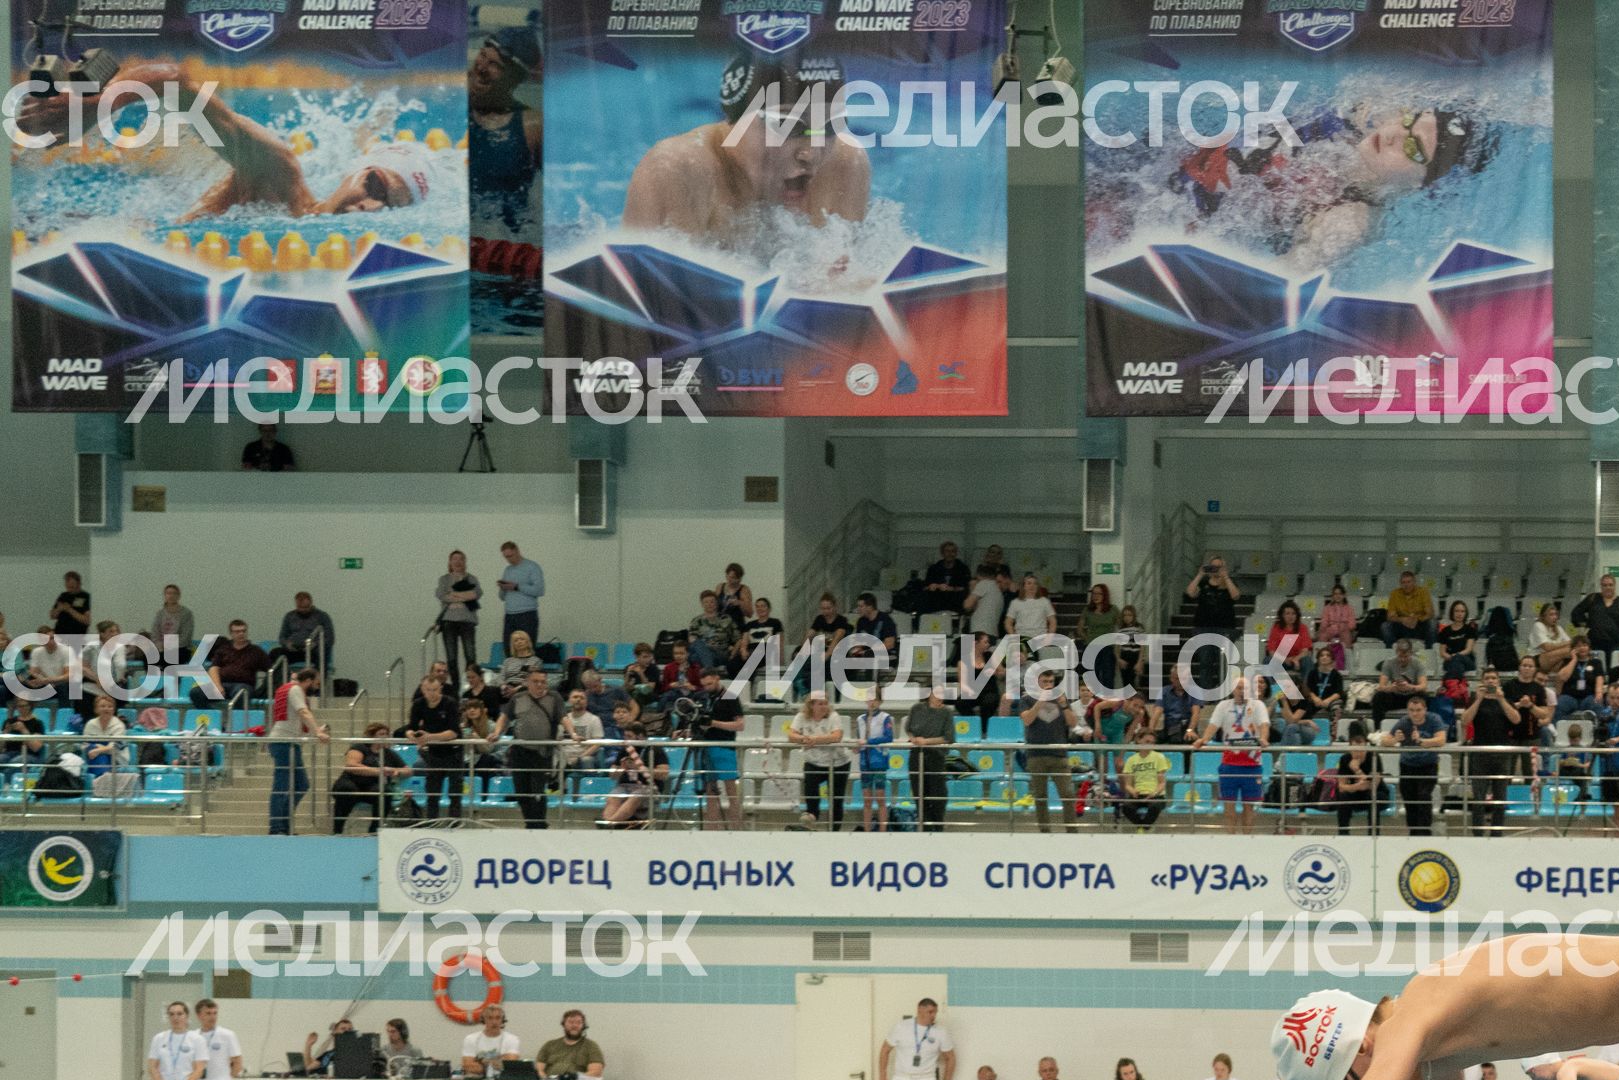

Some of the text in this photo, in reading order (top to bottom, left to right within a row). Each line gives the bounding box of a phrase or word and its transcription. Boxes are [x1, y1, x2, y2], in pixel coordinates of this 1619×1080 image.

[303, 0, 377, 10] MAD WAVE
[377, 0, 432, 25] 2023
[839, 0, 914, 12] MAD WAVE
[1383, 0, 1458, 9] MAD WAVE
[1458, 0, 1515, 24] 2023
[298, 15, 373, 29] CHALLENGE
[912, 1, 970, 28] 2023
[1149, 14, 1241, 30] ПО ПЛАВАНИЮ
[1379, 13, 1456, 28] CHALLENGE
[204, 12, 271, 36] Challenge
[607, 15, 699, 31] ПО ПЛАВАНИЮ
[740, 16, 808, 39] Challenge
[835, 17, 912, 31] CHALLENGE
[1283, 11, 1351, 36] Challenge
[48, 358, 102, 374] MAD
[579, 360, 634, 376] MAD
[1122, 361, 1178, 377] MAD
[41, 374, 108, 391] WAVE
[738, 367, 785, 386] BWT
[573, 378, 641, 395] WAVE
[1116, 379, 1184, 395] WAVE
[473, 857, 612, 889] ДВОРЕЦ
[647, 859, 795, 891] ВОДНЫХ
[829, 860, 949, 892] ВИДОВ
[984, 861, 1116, 891] СПОРТА
[1150, 862, 1269, 894] «РУЗА»
[1304, 1005, 1338, 1068] ВОСТОК
[1323, 1022, 1344, 1062] БЕРГЕР
